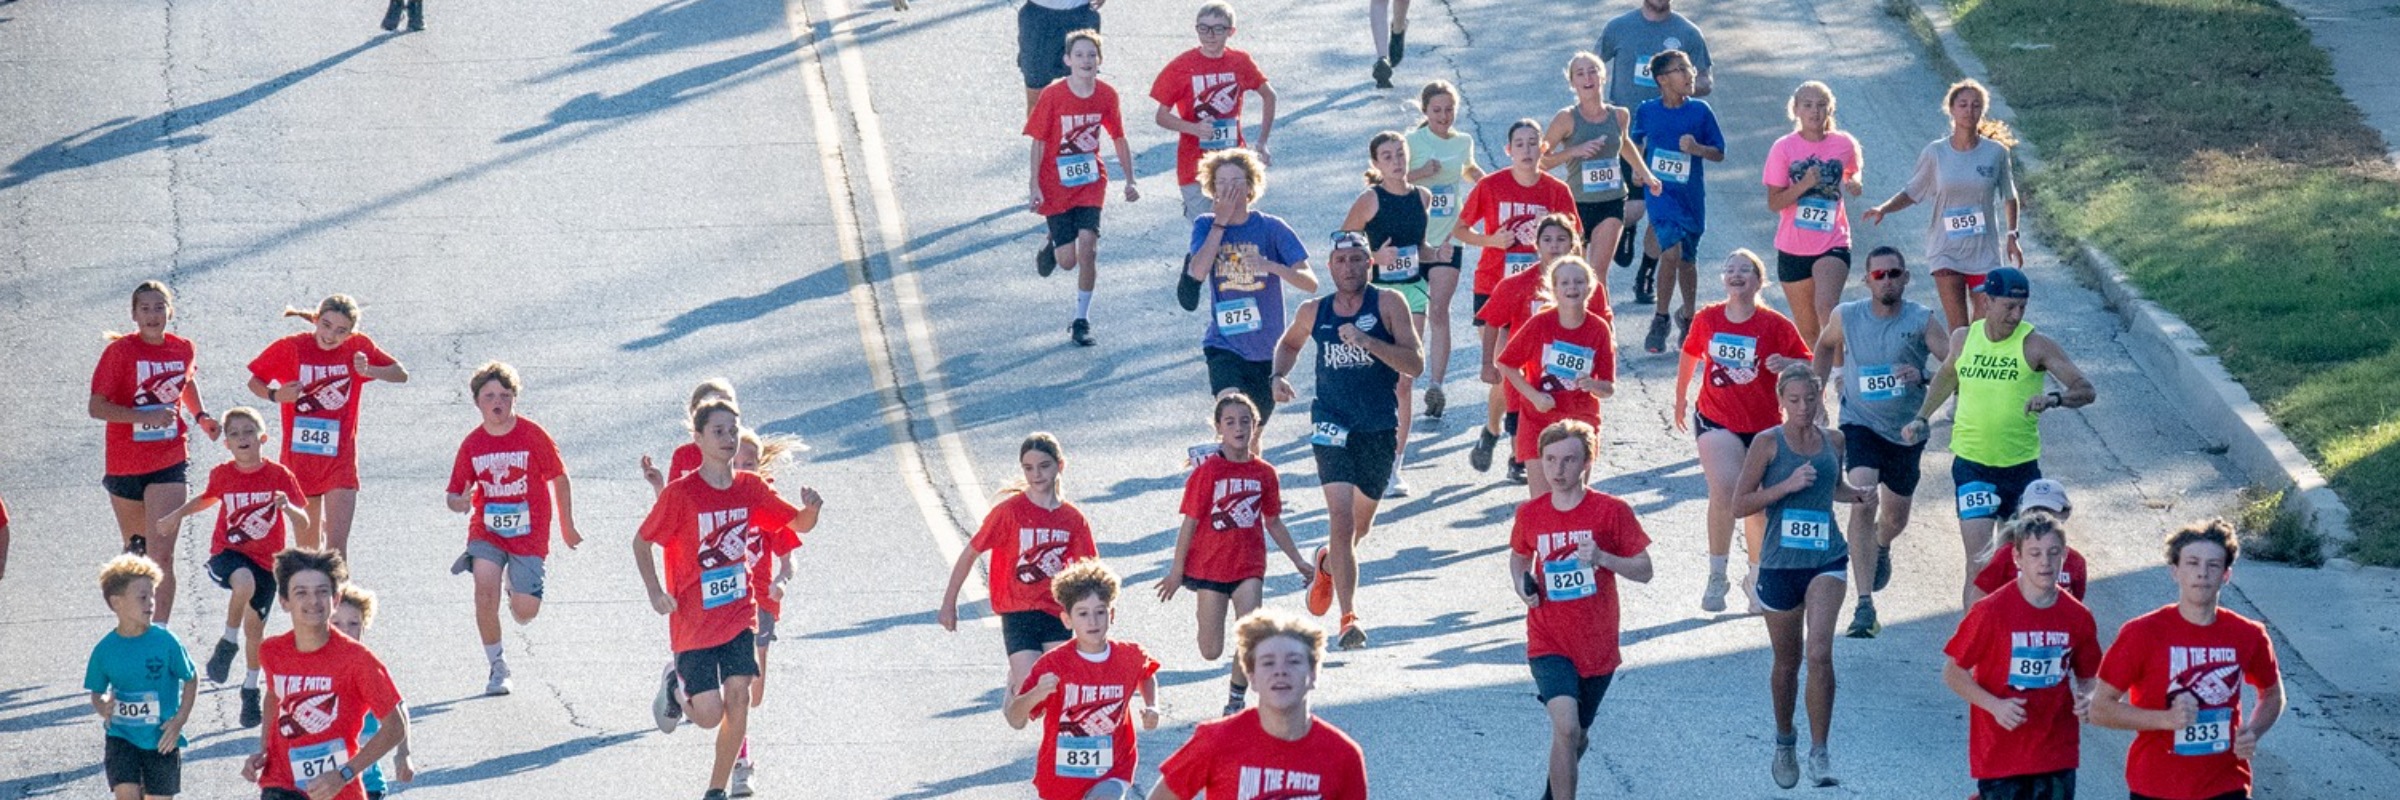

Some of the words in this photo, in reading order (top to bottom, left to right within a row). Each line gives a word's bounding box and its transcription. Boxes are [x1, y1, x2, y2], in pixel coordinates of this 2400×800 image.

[1211, 128, 1228, 140] 91
[1066, 162, 1090, 177] 868
[1658, 159, 1683, 173] 879
[1590, 169, 1613, 182] 880
[1431, 195, 1448, 207] 89
[1802, 207, 1828, 222] 872
[1951, 215, 1977, 229] 859
[1225, 308, 1251, 324] 875
[1719, 345, 1746, 360] 836
[151, 361, 164, 376] THE
[164, 361, 184, 372] PATCH
[1556, 353, 1585, 371] 888
[1973, 354, 2018, 368] TULSA
[314, 365, 326, 381] THE
[328, 364, 348, 376] PATCH
[1960, 366, 2019, 381] RUNNER
[1867, 375, 1896, 390] 850
[301, 429, 330, 444] 848
[1230, 478, 1242, 494] THE
[1244, 478, 1262, 491] PATCH
[1966, 493, 1992, 508] 851
[493, 514, 521, 529] 857
[714, 510, 728, 529] THE
[728, 507, 748, 522] PATCH
[1036, 528, 1050, 546] THE
[1052, 528, 1070, 542] PATCH
[1790, 522, 1819, 537] 881
[1552, 532, 1566, 551] THE
[1568, 530, 1592, 545] PATCH
[710, 577, 737, 596] 864
[1553, 571, 1585, 589] 820
[2029, 631, 2044, 647] THE
[2046, 630, 2070, 646] PATCH
[2189, 647, 2207, 667] THE
[2209, 648, 2236, 662] PATCH
[2020, 659, 2052, 675] 897
[288, 675, 303, 694] THE
[304, 676, 332, 692] PATCH
[1081, 684, 1098, 704] THE
[1099, 684, 1124, 700] PATCH
[119, 702, 150, 717] 804
[2184, 723, 2219, 742] 833
[1066, 750, 1100, 765] 831
[303, 754, 338, 777] 871
[1264, 768, 1284, 793] THE
[1286, 770, 1320, 791] PATCH
